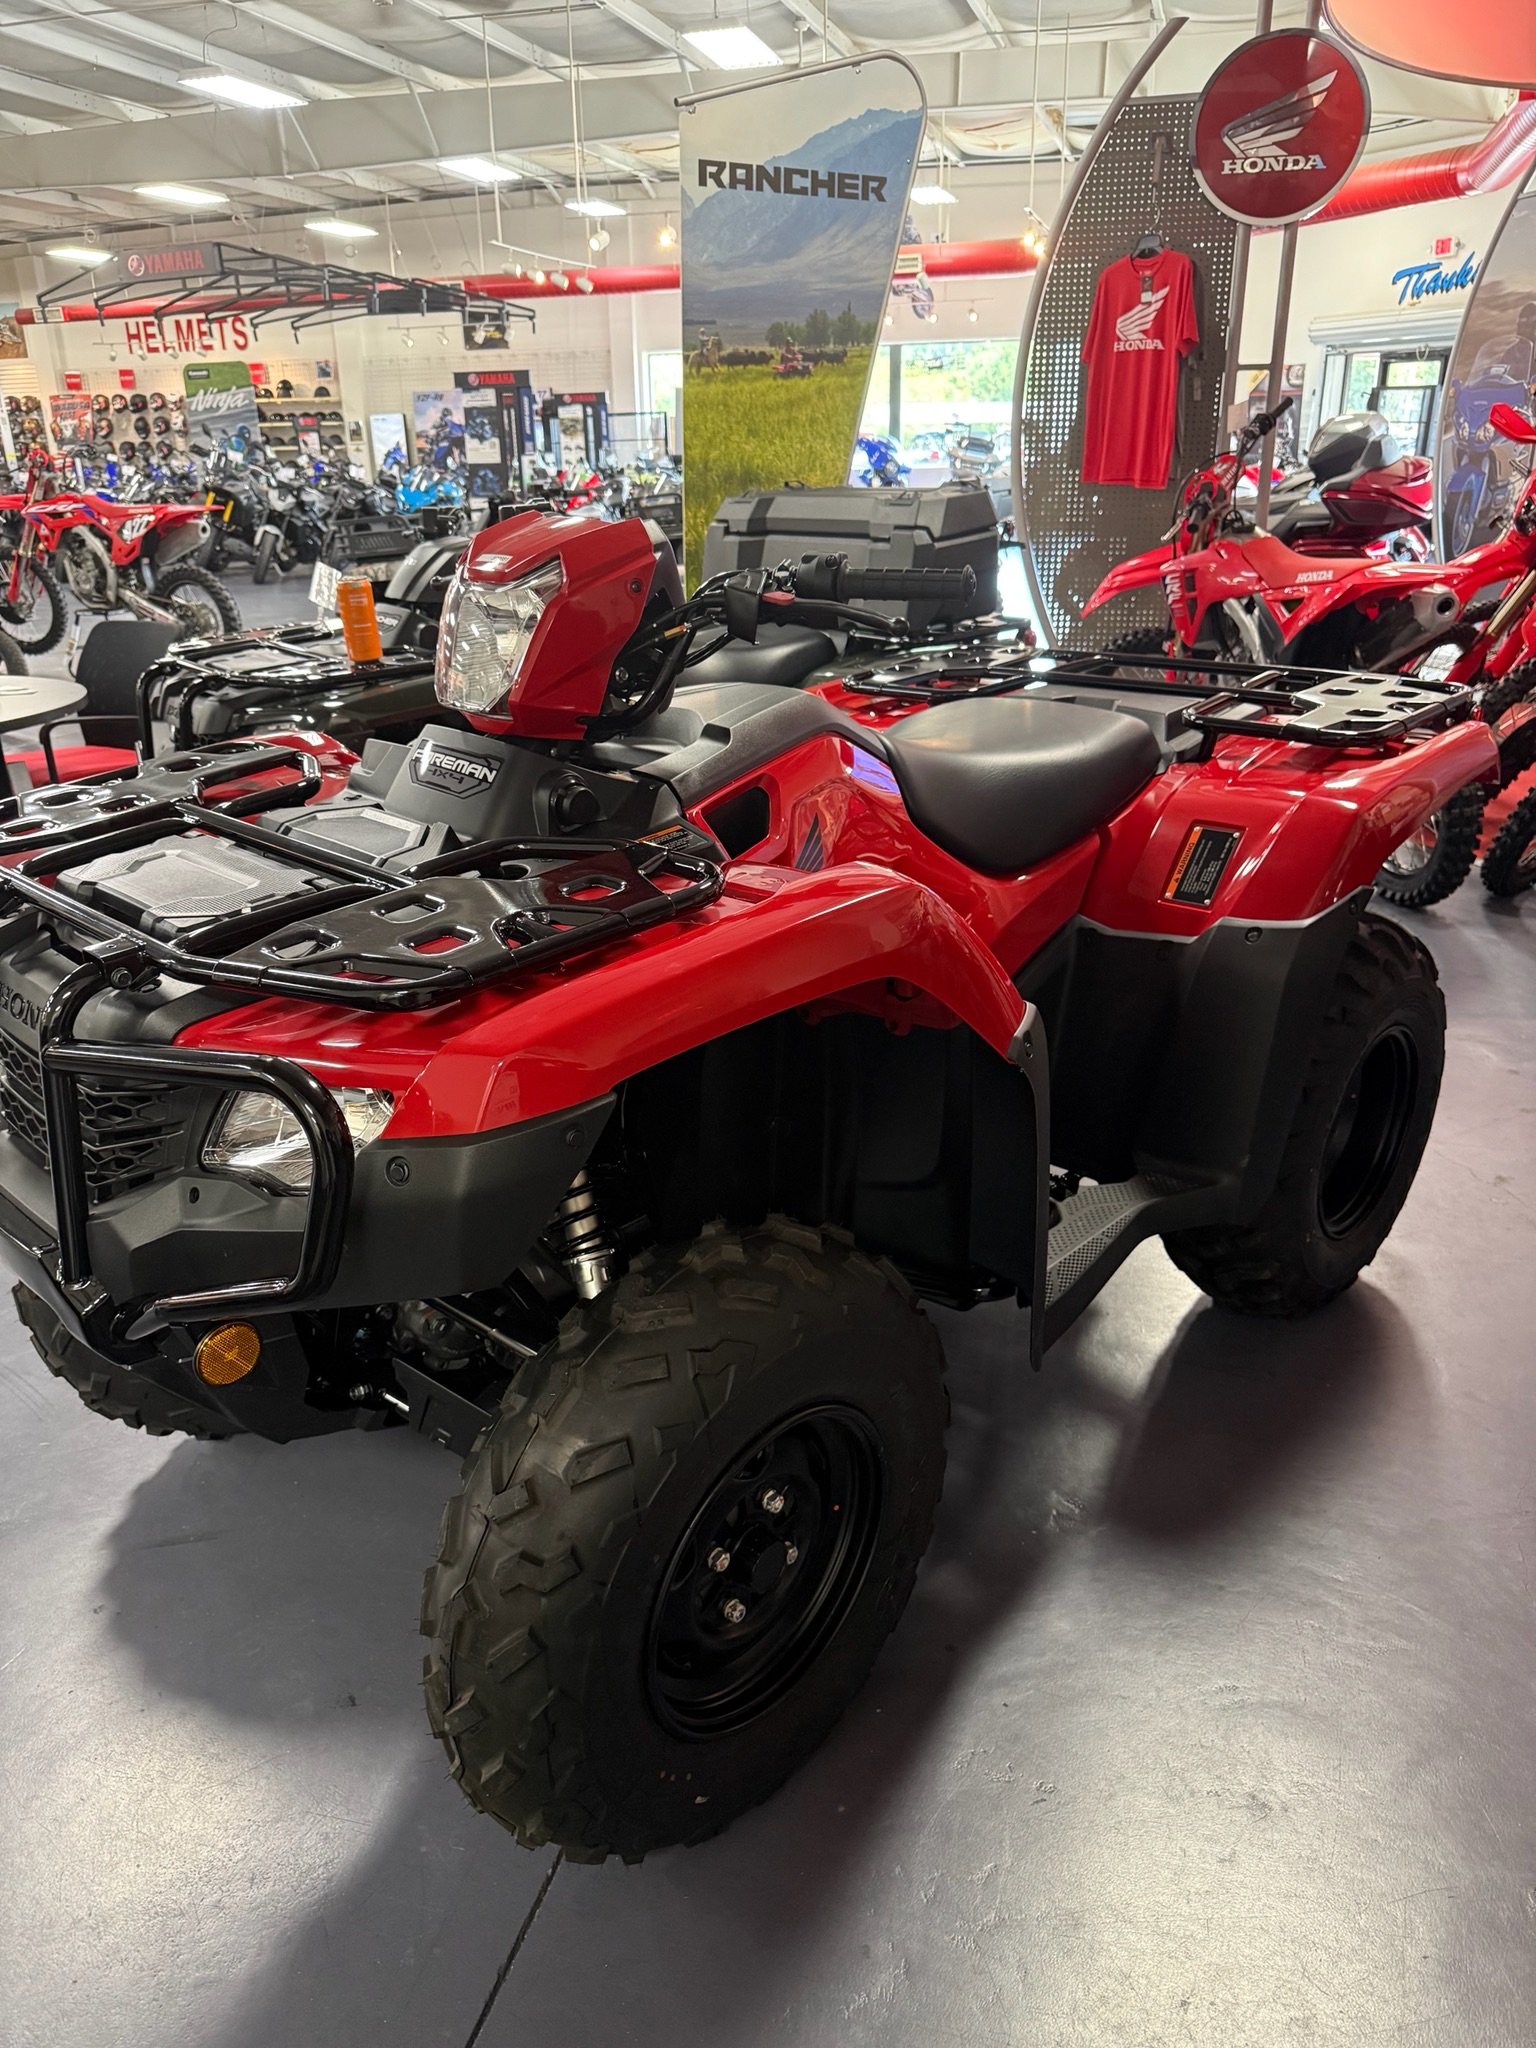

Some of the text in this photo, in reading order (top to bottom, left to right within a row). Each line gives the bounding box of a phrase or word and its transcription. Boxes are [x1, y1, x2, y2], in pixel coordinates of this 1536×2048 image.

[1221, 154, 1327, 175] HONDA
[698, 158, 887, 203] RANCHER
[143, 249, 204, 274] YAMAHA
[125, 316, 249, 354] HELMETS
[478, 373, 515, 385] YAMAHA
[190, 385, 250, 416] Ninja
[1165, 573, 1182, 605] CRF
[1296, 570, 1333, 583] HONDA
[412, 748, 497, 783] FREMAN
[1175, 842, 1195, 876] WARNING
